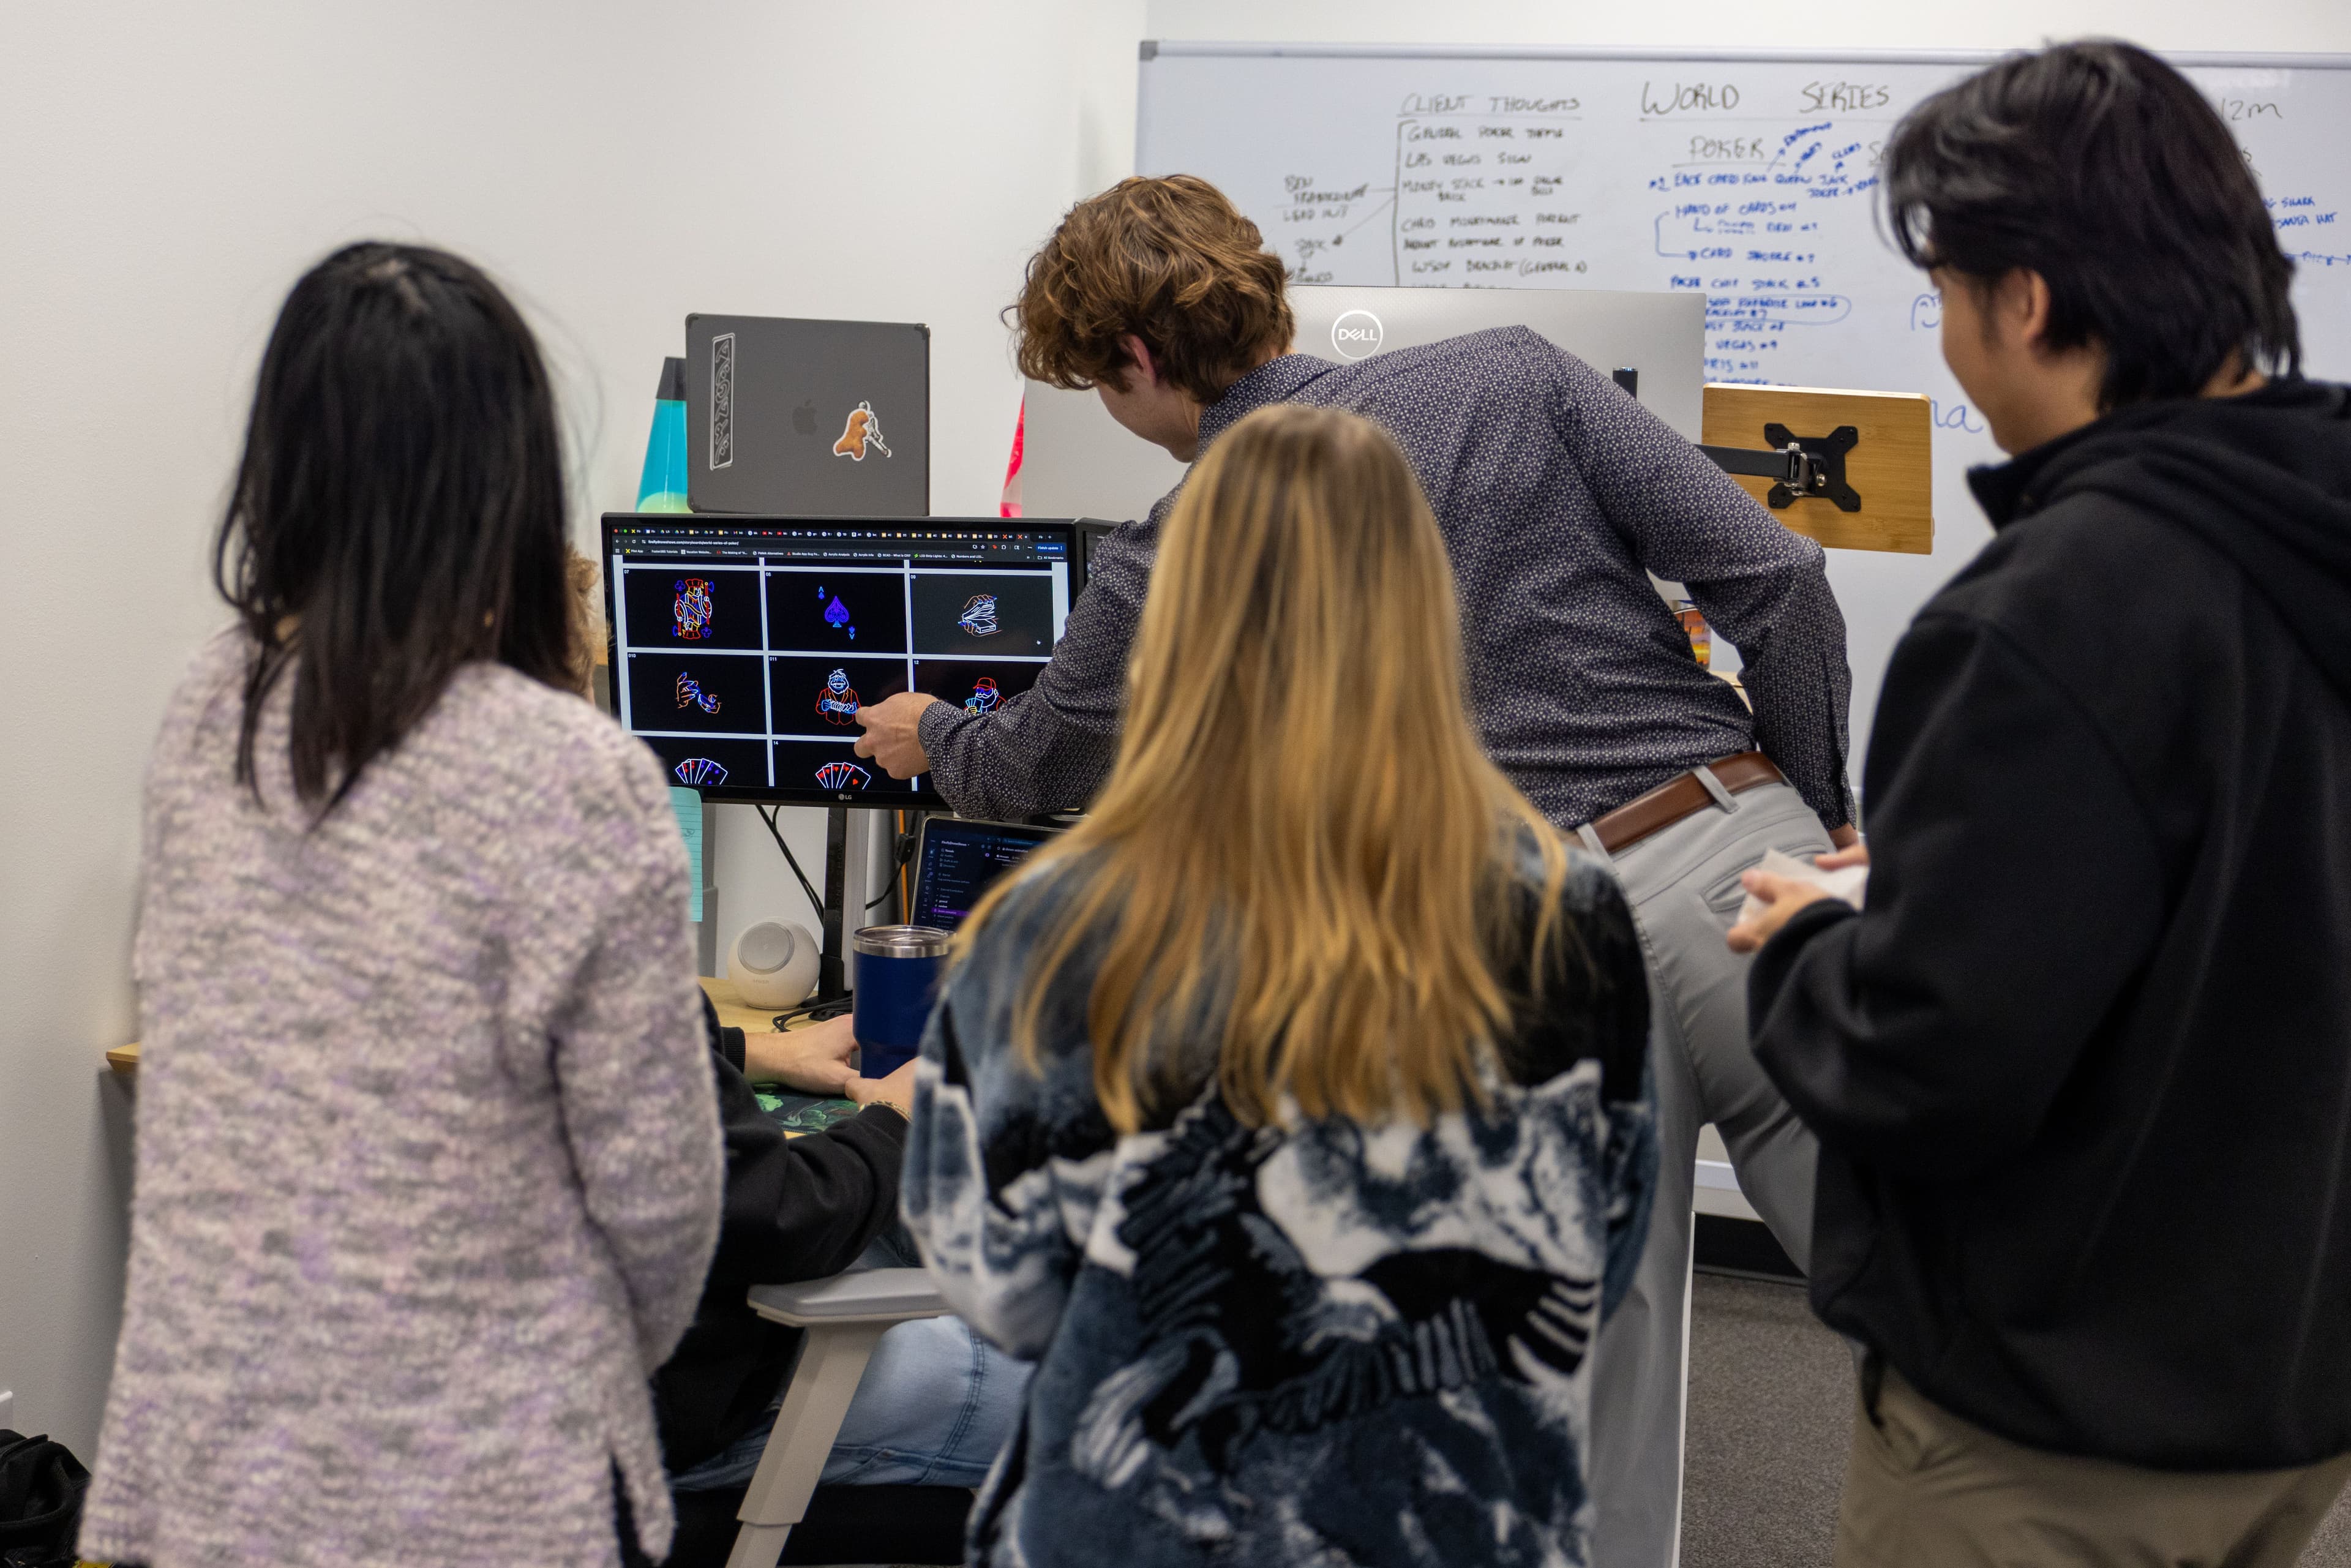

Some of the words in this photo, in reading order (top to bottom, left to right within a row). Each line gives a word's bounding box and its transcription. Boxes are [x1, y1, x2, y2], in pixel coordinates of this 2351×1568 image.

[1401, 93, 1474, 113] CLIENT
[1489, 96, 1580, 113] THOUGHTS
[1641, 81, 1739, 114] WORLD
[1799, 82, 1889, 113] SERIES
[1689, 135, 1764, 160] POKER
[2316, 212, 2338, 224] HAT
[1338, 328, 1378, 341] DELL
